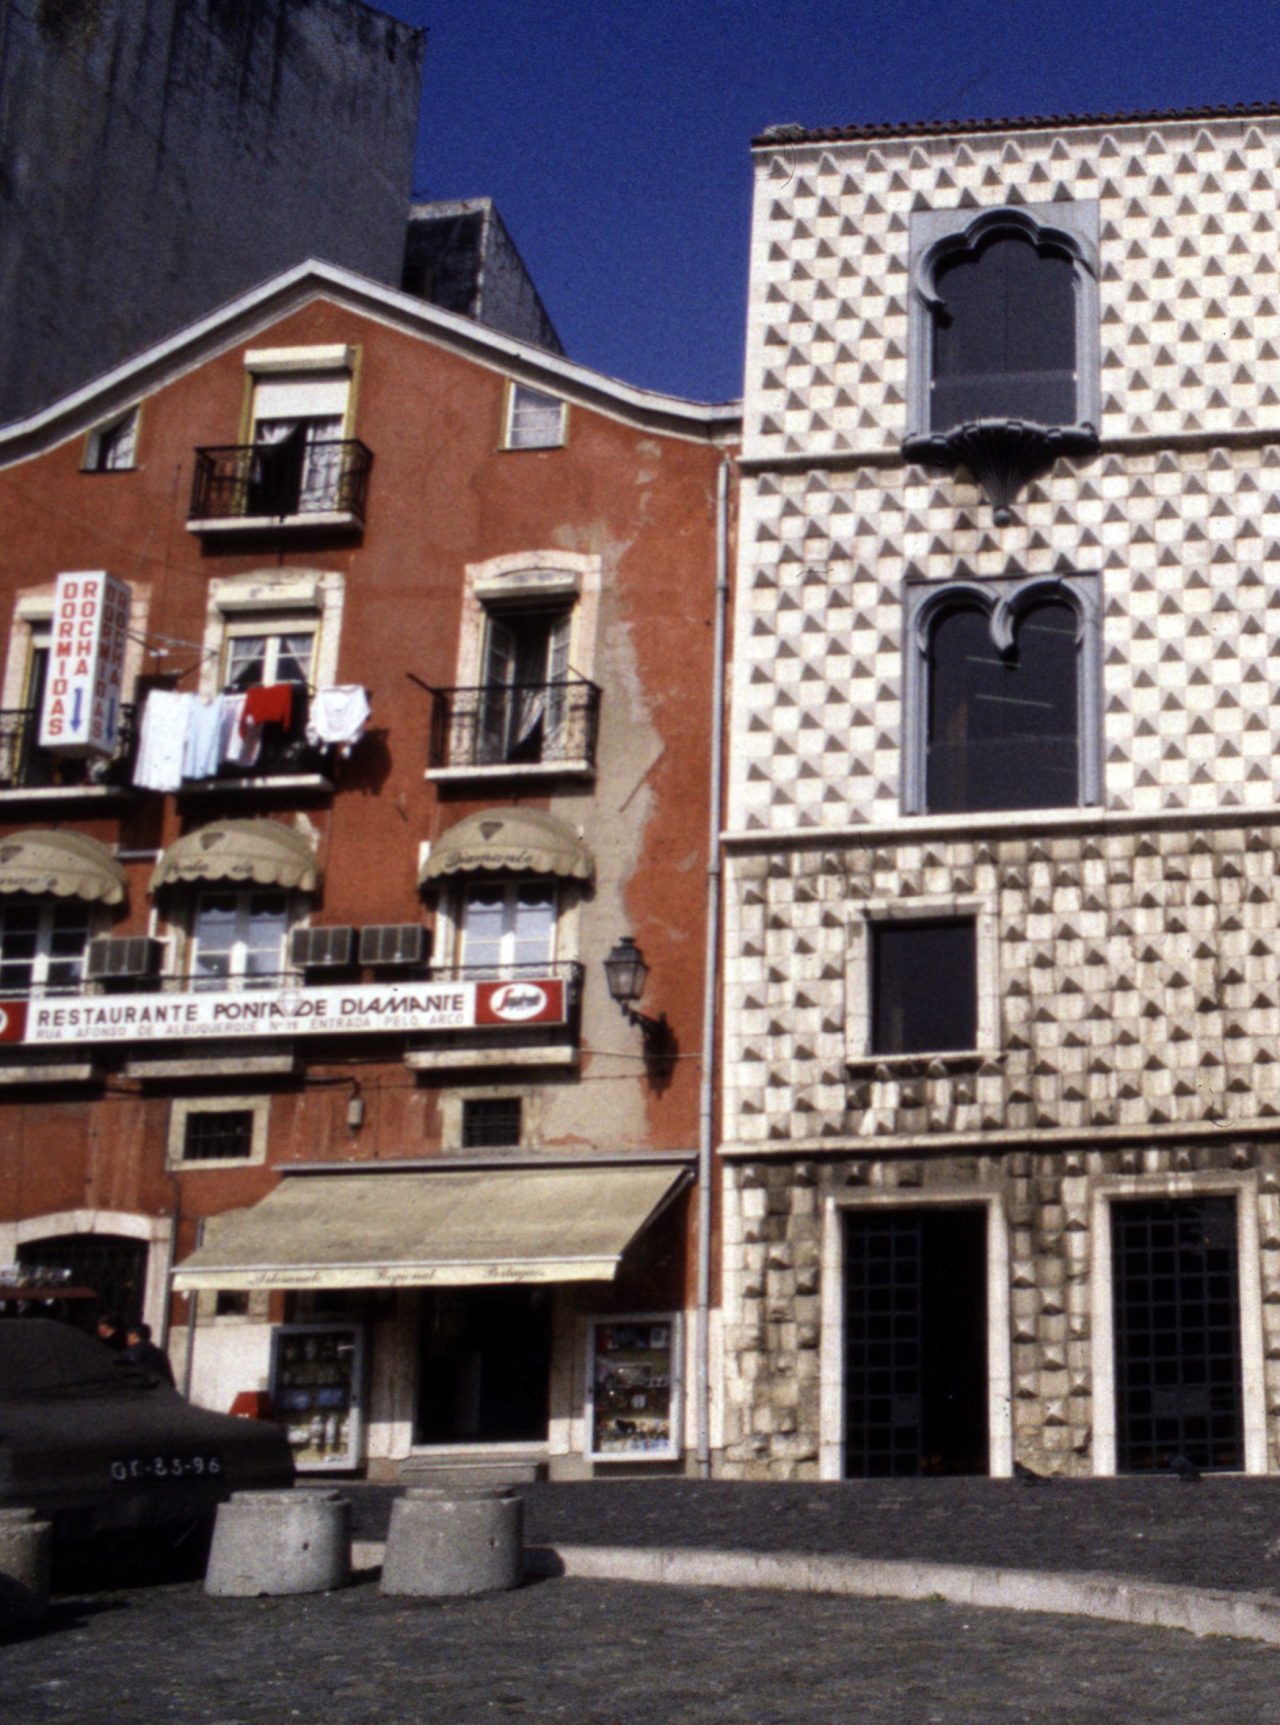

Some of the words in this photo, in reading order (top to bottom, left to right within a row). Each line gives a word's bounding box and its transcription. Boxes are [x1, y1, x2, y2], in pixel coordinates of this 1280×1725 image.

[48, 582, 78, 736] DORMIDAS
[74, 581, 98, 676] ROCHA
[36, 1028, 62, 1040] RUA
[76, 1026, 127, 1038] AFONSO
[138, 1025, 153, 1037] DE
[166, 1022, 257, 1036] ALBUQUERQUE
[310, 1017, 371, 1030] ENTRADA
[384, 1015, 419, 1027] PELO
[430, 1013, 464, 1026] ARCO
[37, 1004, 198, 1026] RESTAURANTE
[214, 1002, 285, 1020] PONTA
[293, 1000, 327, 1017] DE
[341, 994, 465, 1015] DIAMANTE
